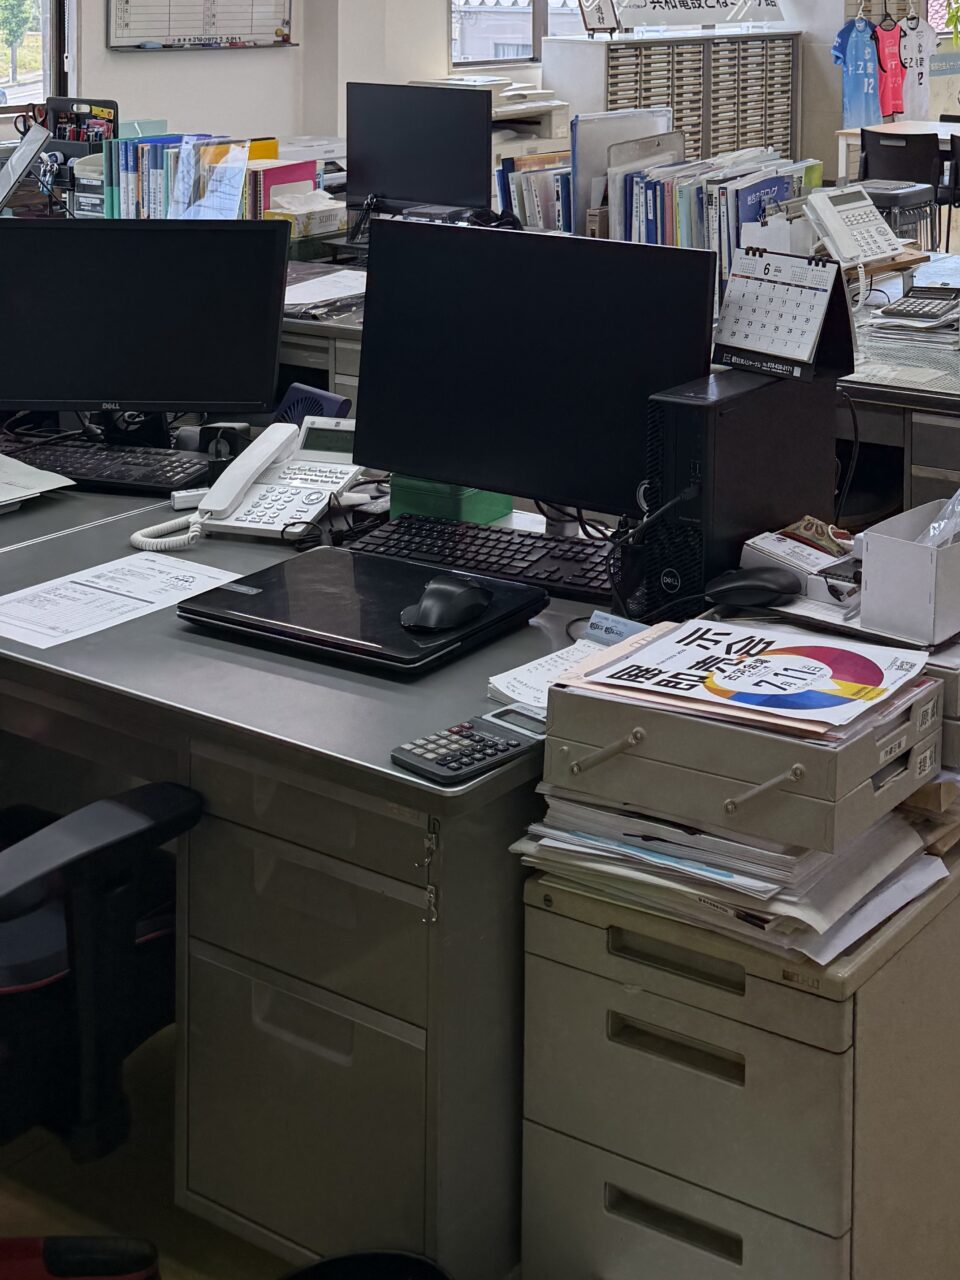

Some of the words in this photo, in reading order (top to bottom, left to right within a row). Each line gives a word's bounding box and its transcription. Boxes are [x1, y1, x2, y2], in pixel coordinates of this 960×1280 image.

[864, 78, 874, 93] 12
[764, 263, 770, 275] 6
[651, 636, 776, 691] 即売会
